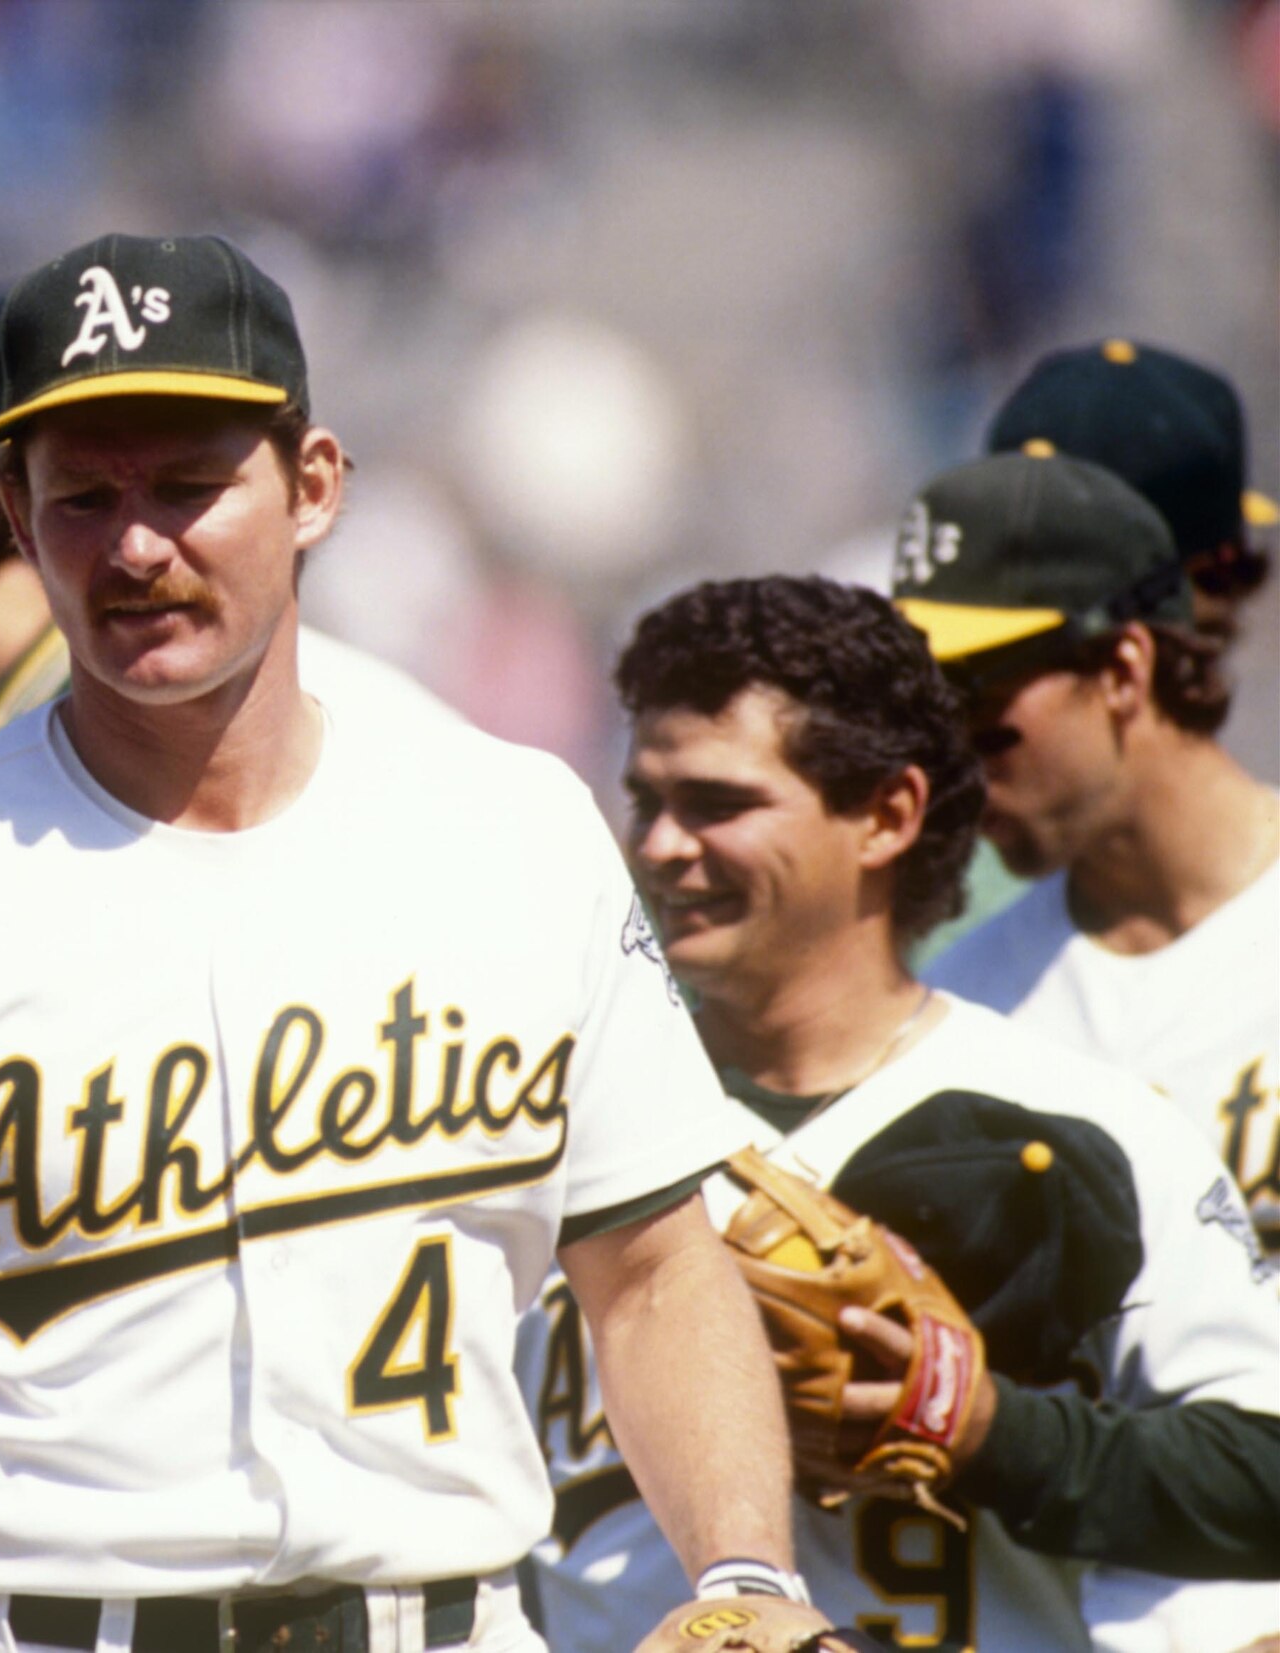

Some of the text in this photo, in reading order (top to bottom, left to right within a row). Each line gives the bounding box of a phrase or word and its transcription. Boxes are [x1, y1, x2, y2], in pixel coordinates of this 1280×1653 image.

[61, 265, 171, 368] A's
[344, 1233, 461, 1446] 4
[852, 1498, 979, 1653] 9
